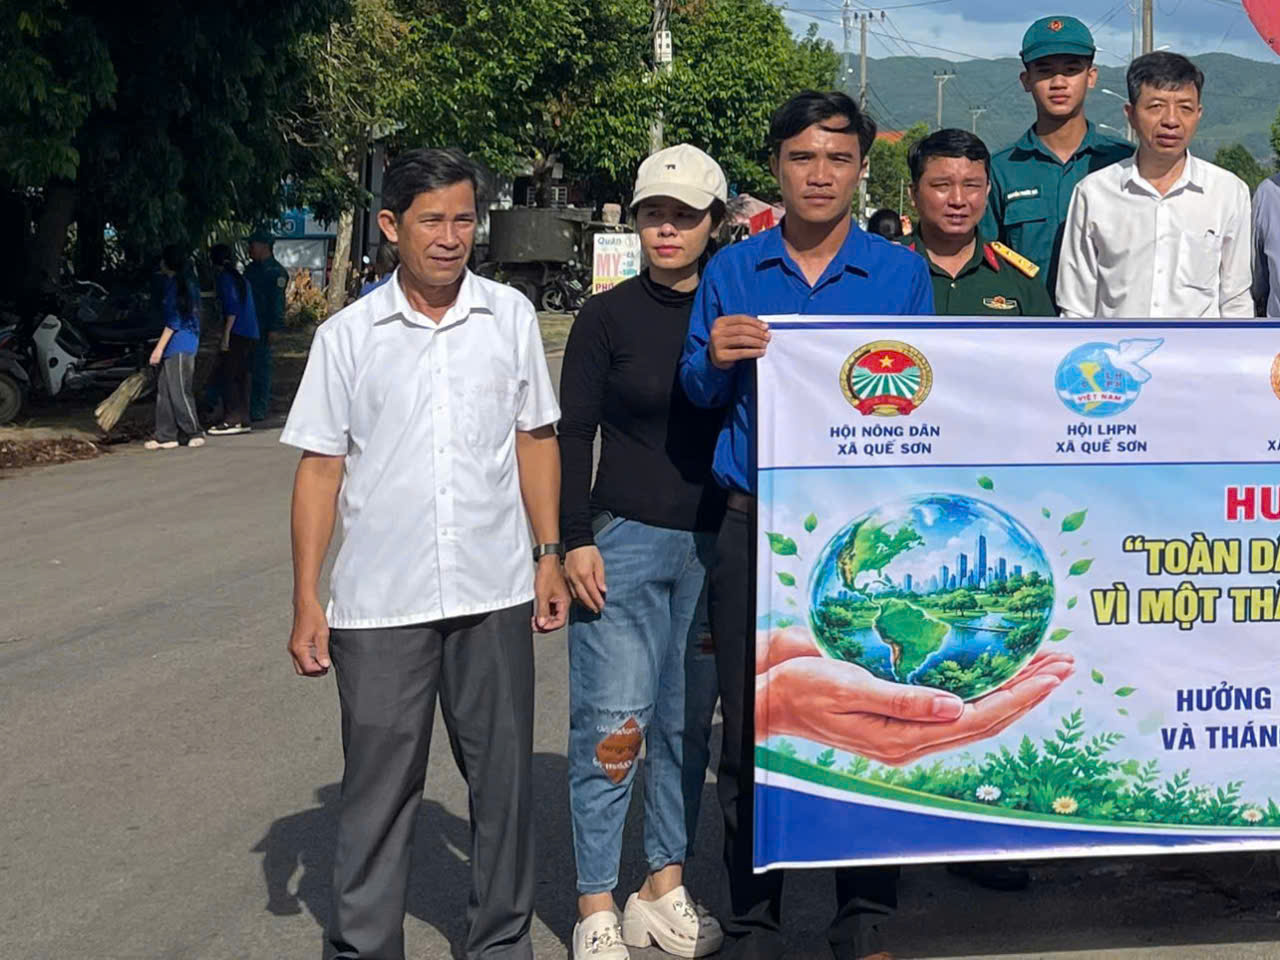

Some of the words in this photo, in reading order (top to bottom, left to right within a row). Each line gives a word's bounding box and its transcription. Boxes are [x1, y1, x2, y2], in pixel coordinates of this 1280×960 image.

[830, 425, 855, 439] HỘI
[862, 425, 904, 437] NÔNG
[909, 423, 940, 437] DÂN
[1067, 423, 1092, 436] HỘI
[1098, 424, 1136, 435] LHPN
[838, 442, 858, 455] XÃ
[864, 439, 896, 455] QUẾ
[901, 442, 932, 454] SƠN
[1056, 440, 1075, 453] XÃ
[1081, 438, 1113, 453] QUẾ
[1118, 440, 1147, 452] SƠN
[1123, 533, 1241, 575] “TOÀN
[1091, 582, 1130, 625] VÌ
[1138, 581, 1220, 630] MỘT
[1176, 681, 1272, 712] HƯỞNG
[1161, 722, 1196, 750] VÀ
